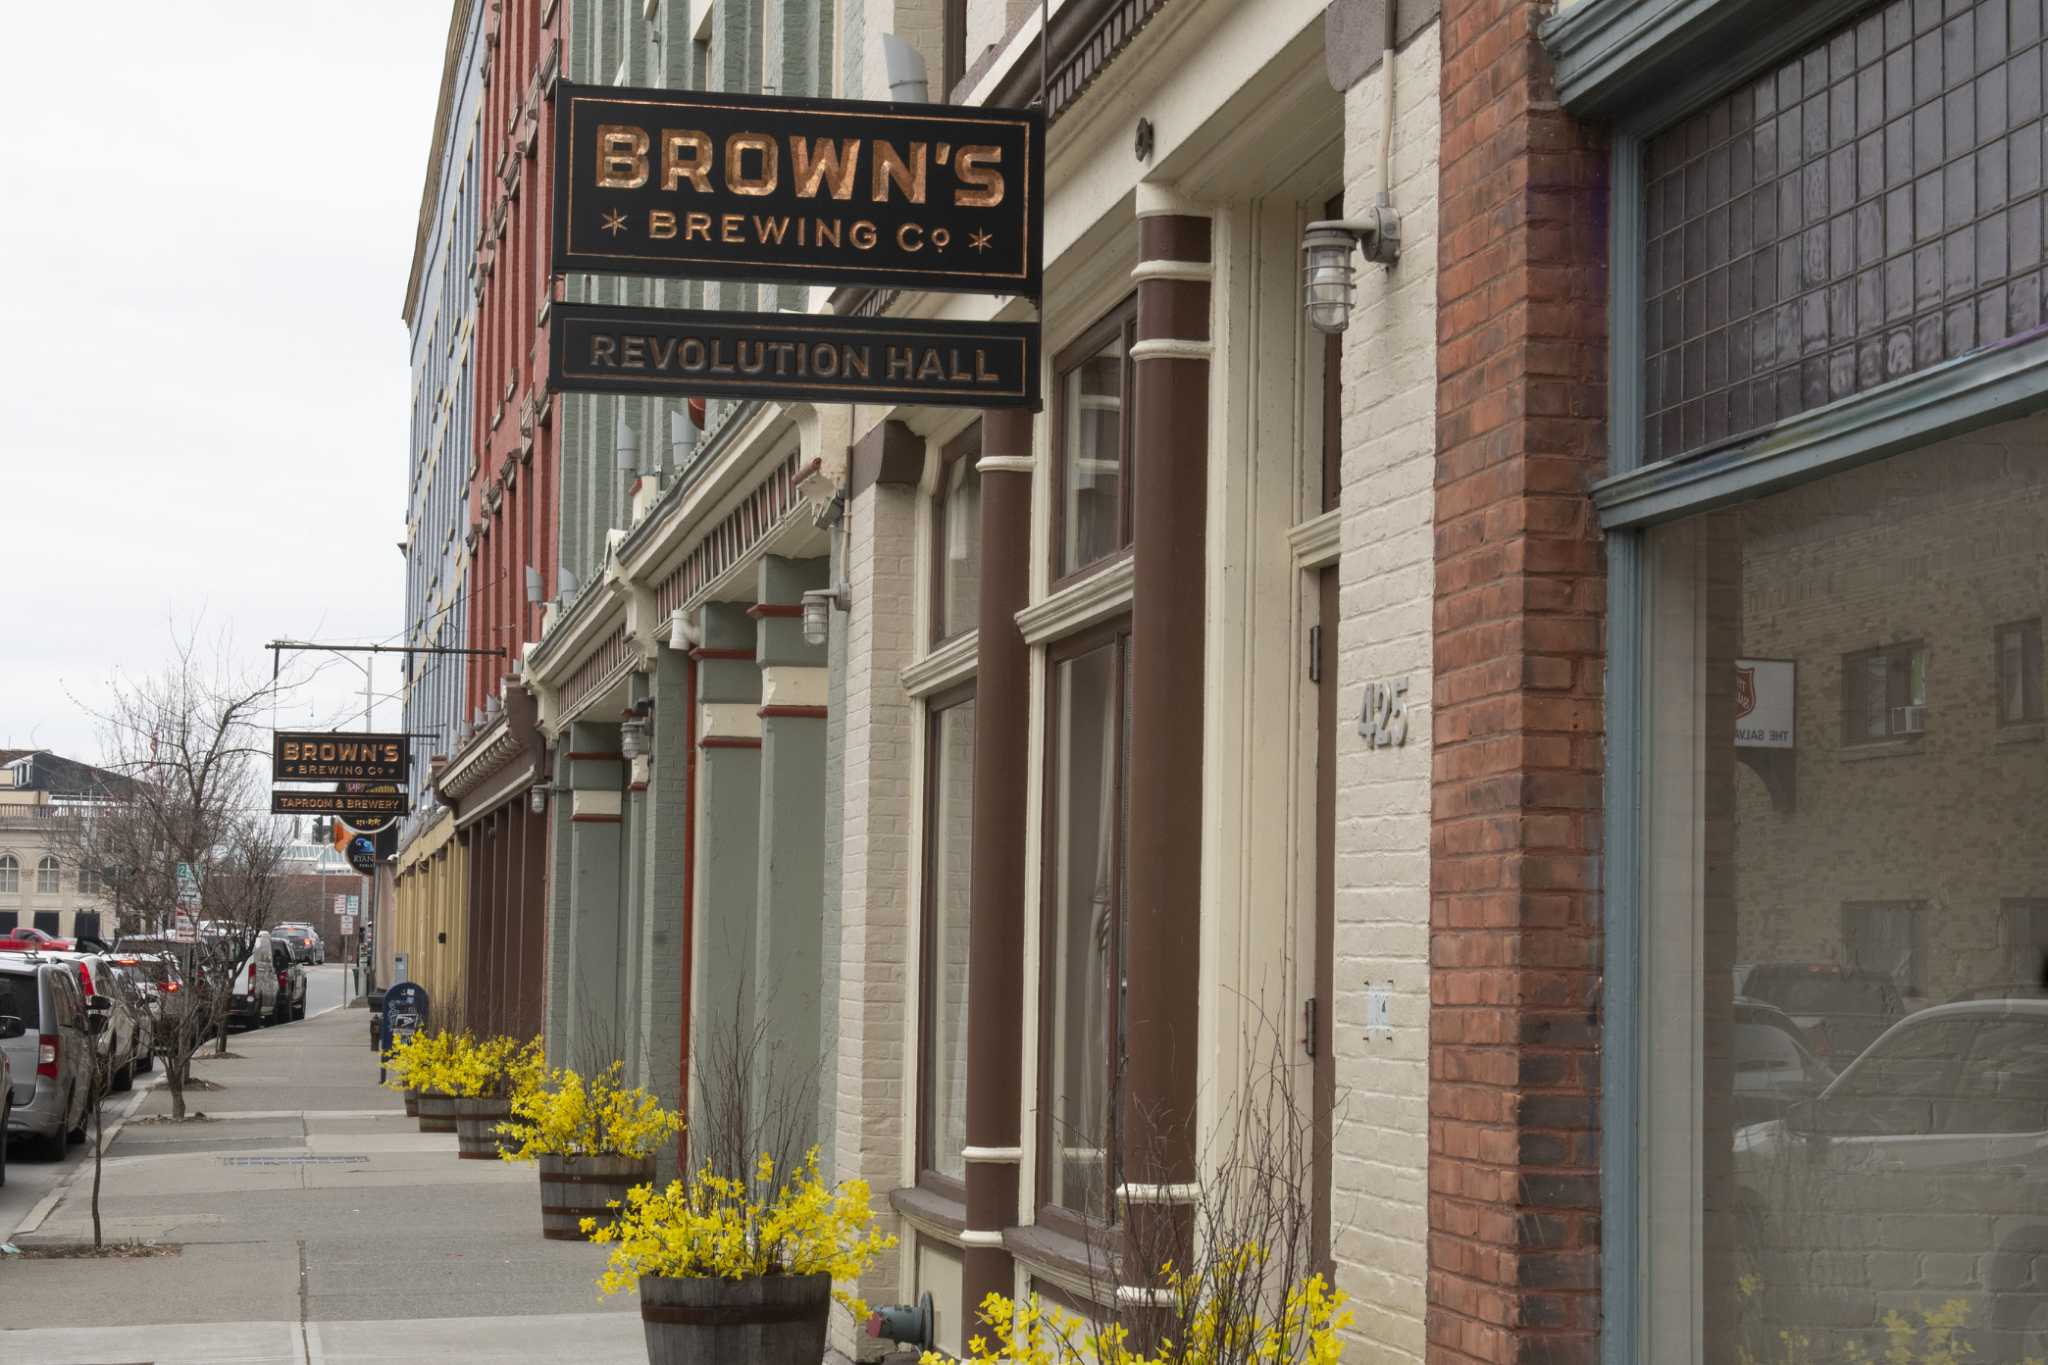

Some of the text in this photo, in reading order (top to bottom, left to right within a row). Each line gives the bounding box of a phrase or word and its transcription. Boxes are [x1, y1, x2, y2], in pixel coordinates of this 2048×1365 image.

[594, 123, 1005, 208] BROWN'S
[648, 209, 878, 250] BREWING
[589, 335, 1000, 383] REVOLUTION HALL
[1358, 677, 1408, 750] 425
[283, 741, 399, 762] BROWN'S
[298, 765, 363, 775] BREWING
[280, 797, 399, 809] TAPROOM & BREWERY
